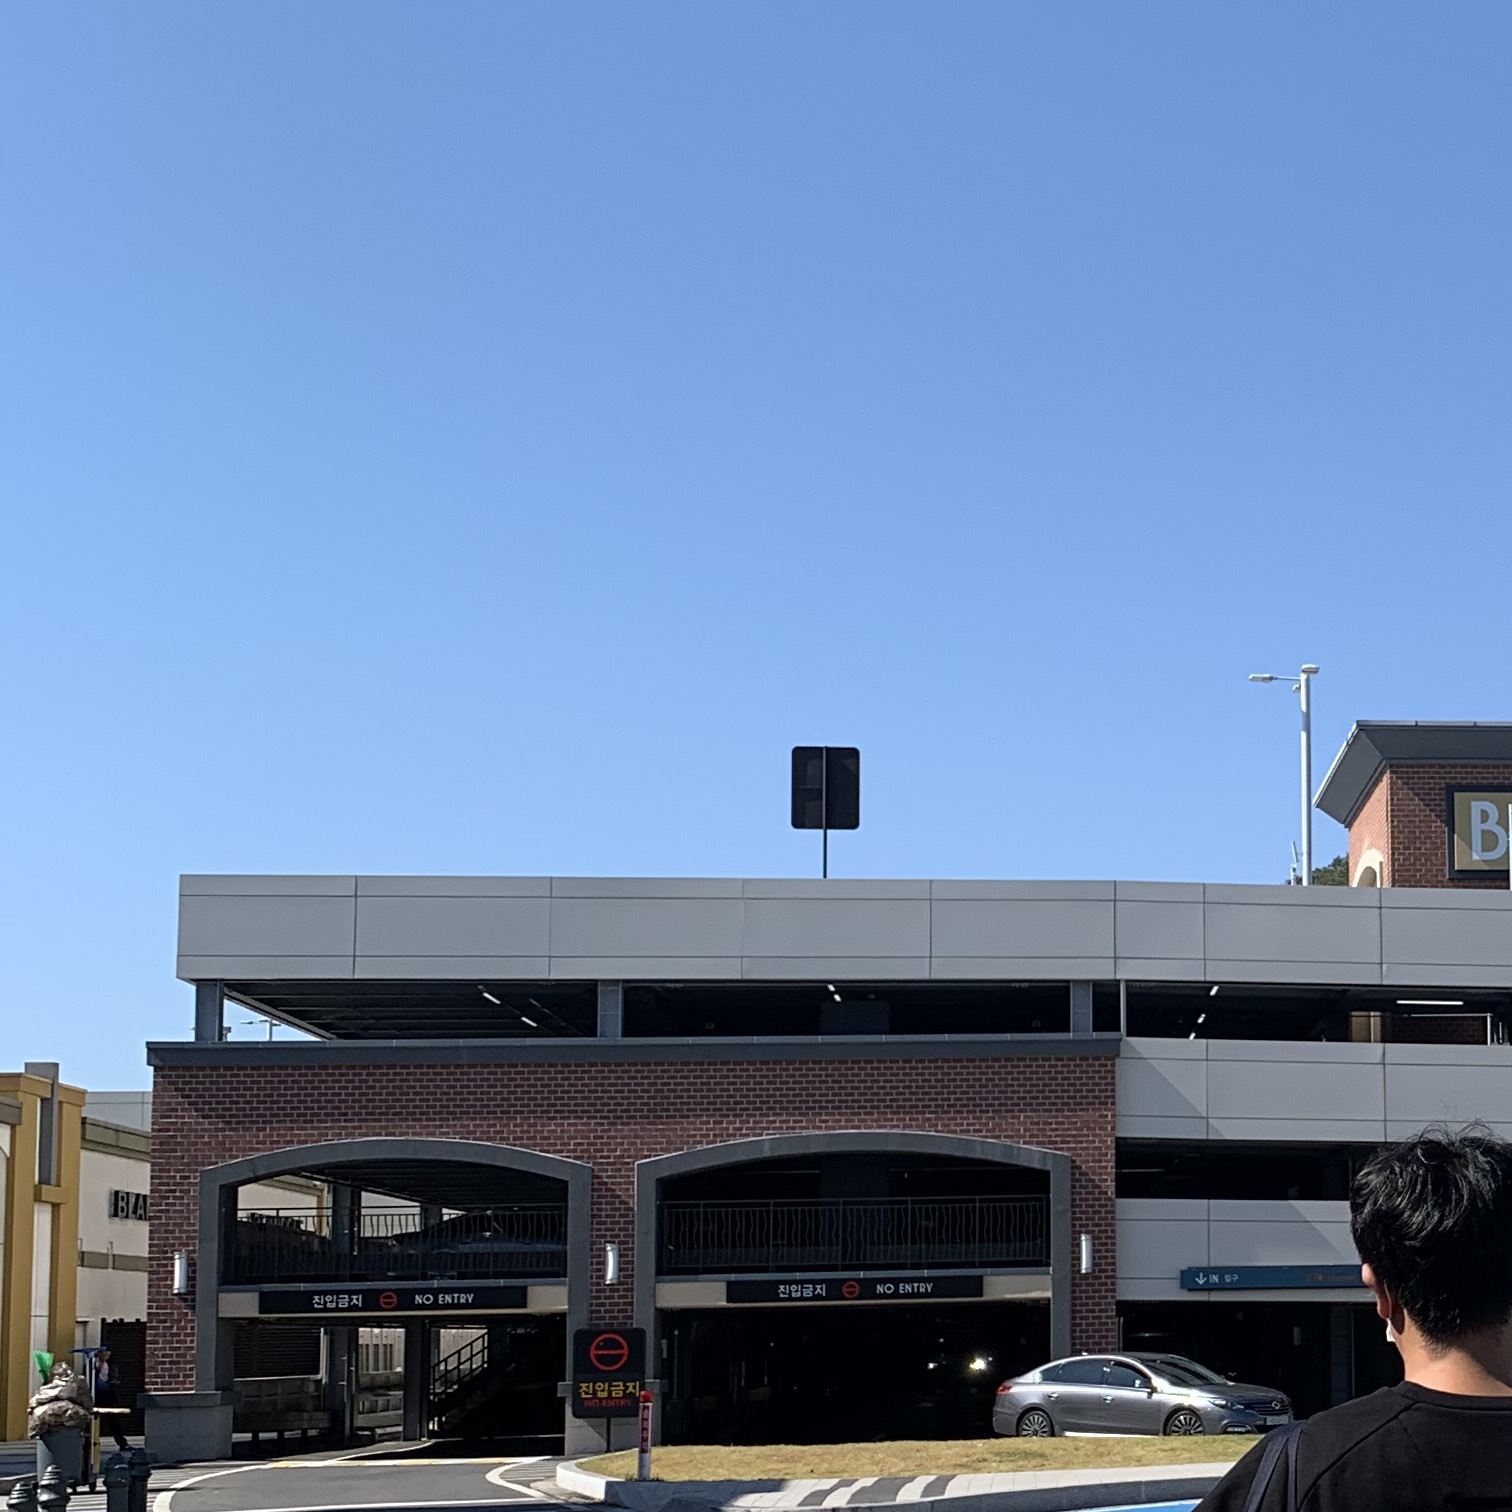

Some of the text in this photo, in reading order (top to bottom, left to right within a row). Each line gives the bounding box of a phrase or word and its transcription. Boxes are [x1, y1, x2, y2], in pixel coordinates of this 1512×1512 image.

[1470, 800, 1509, 861] B
[1208, 1273, 1220, 1284] IN
[777, 1282, 934, 1298] 진입금지 NO ENTRY
[312, 1293, 474, 1309] 진입금지 NO ENTRY
[578, 1380, 640, 1399] 진입금지
[584, 1399, 600, 1408] NO
